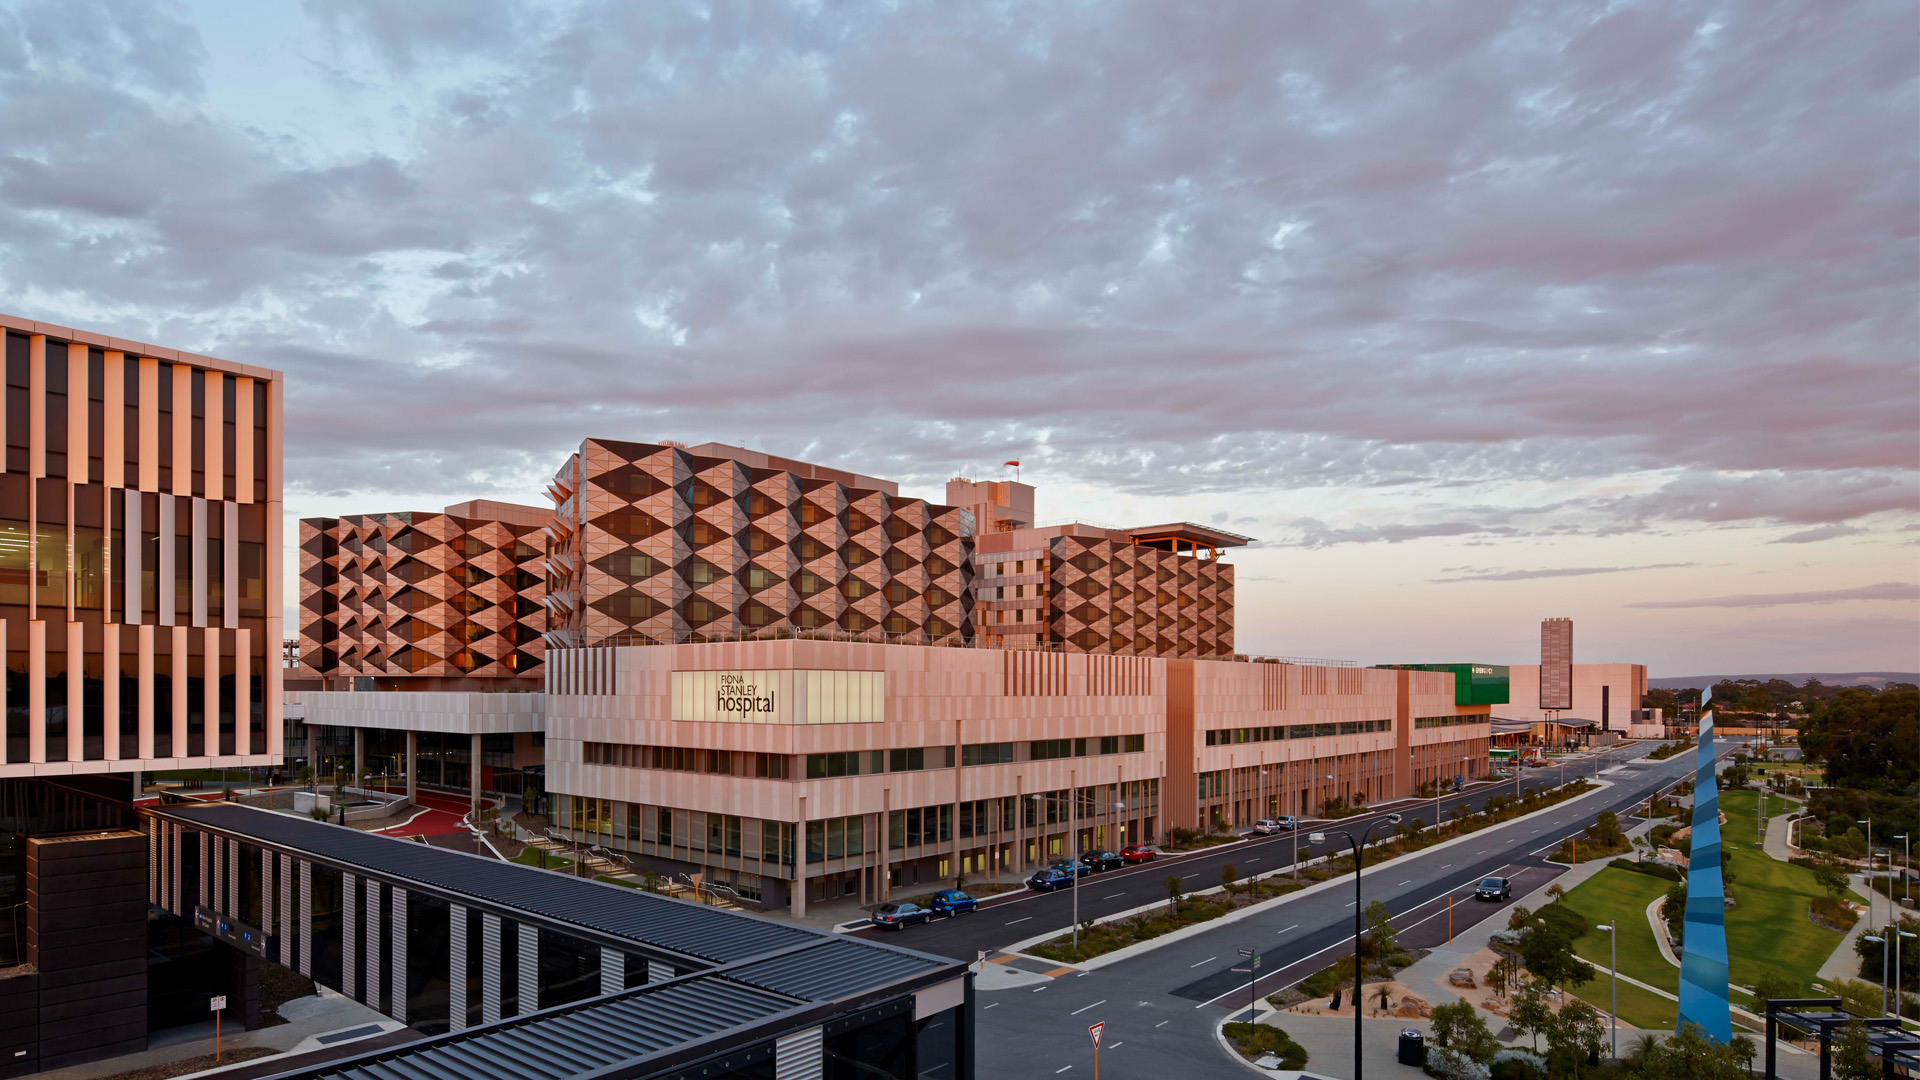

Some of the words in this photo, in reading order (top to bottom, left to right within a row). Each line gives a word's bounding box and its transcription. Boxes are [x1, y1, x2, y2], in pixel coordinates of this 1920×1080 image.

[721, 675, 744, 684] FIONA
[721, 685, 757, 695] STANLEY
[718, 690, 774, 718] hospital
